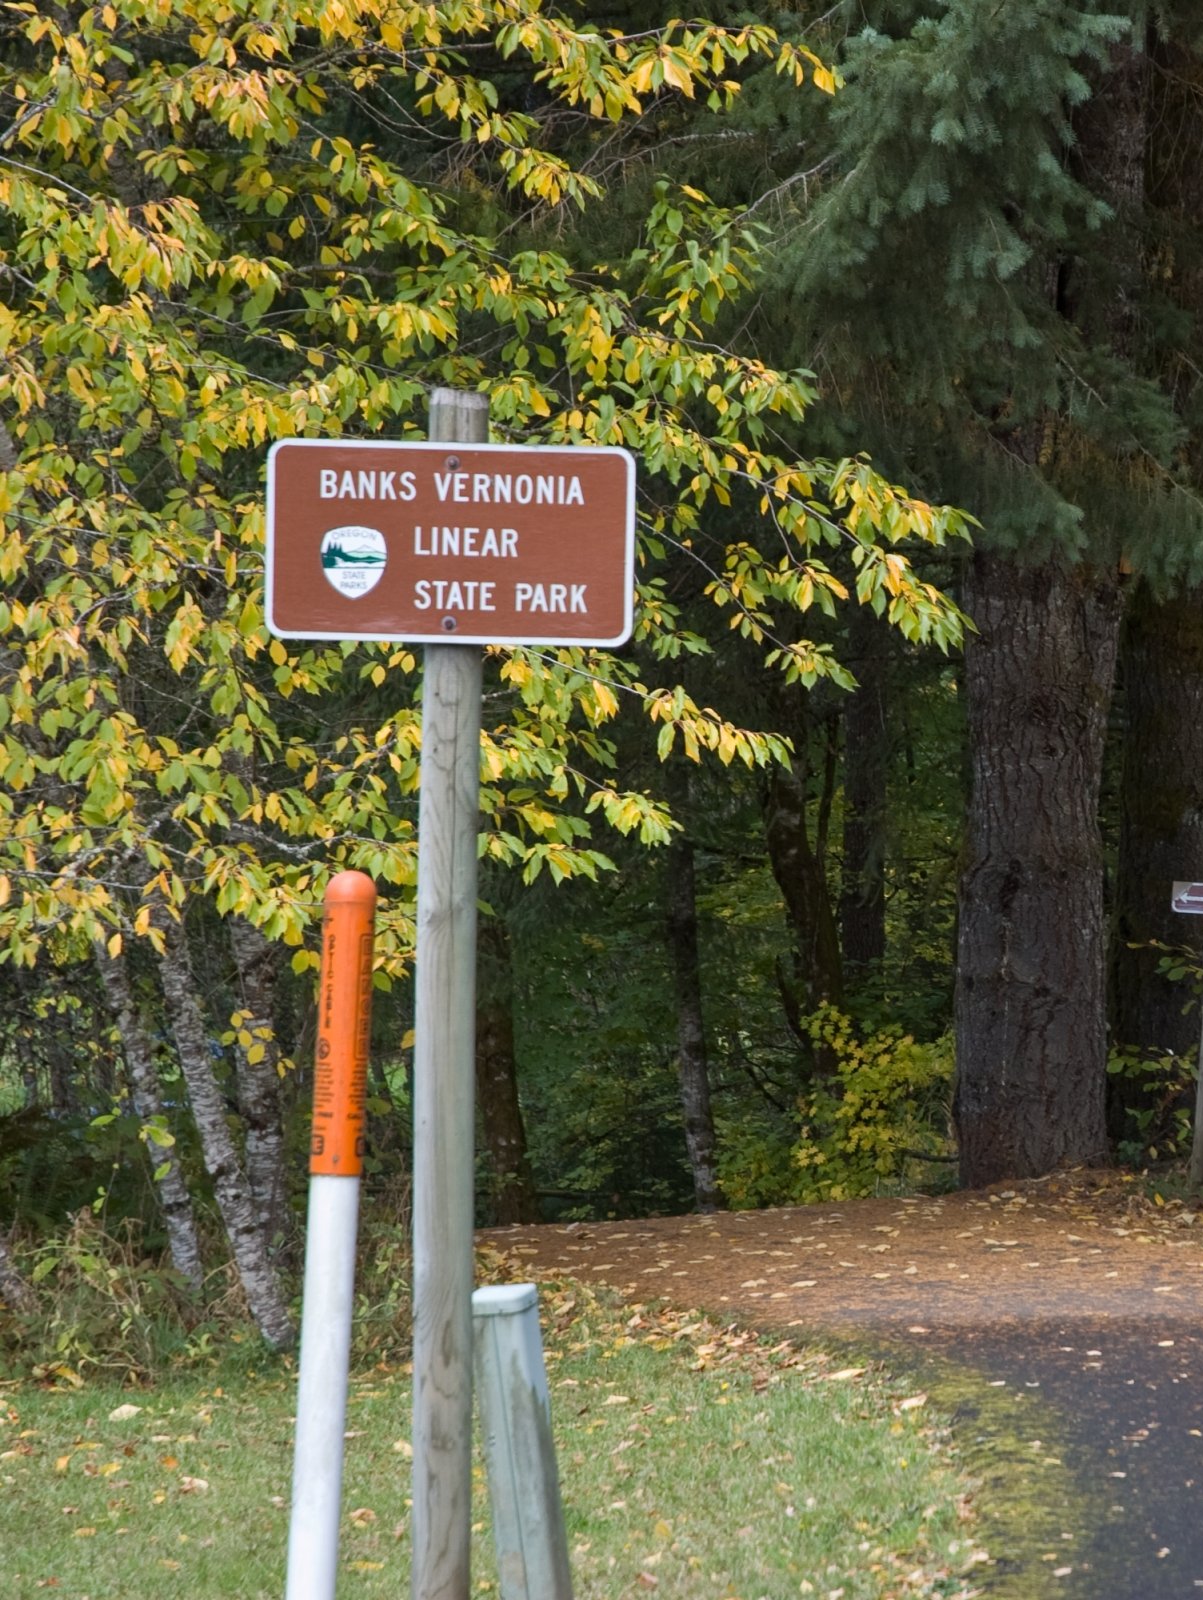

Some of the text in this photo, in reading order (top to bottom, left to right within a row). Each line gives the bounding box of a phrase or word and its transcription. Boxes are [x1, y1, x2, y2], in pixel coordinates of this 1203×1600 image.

[319, 469, 585, 505] BANKS VERNONIA
[331, 528, 378, 541] OREGON
[413, 526, 519, 558] LINEAR
[340, 581, 368, 590] PARKS
[342, 570, 367, 579] STATE
[413, 580, 588, 614] STATE PARK
